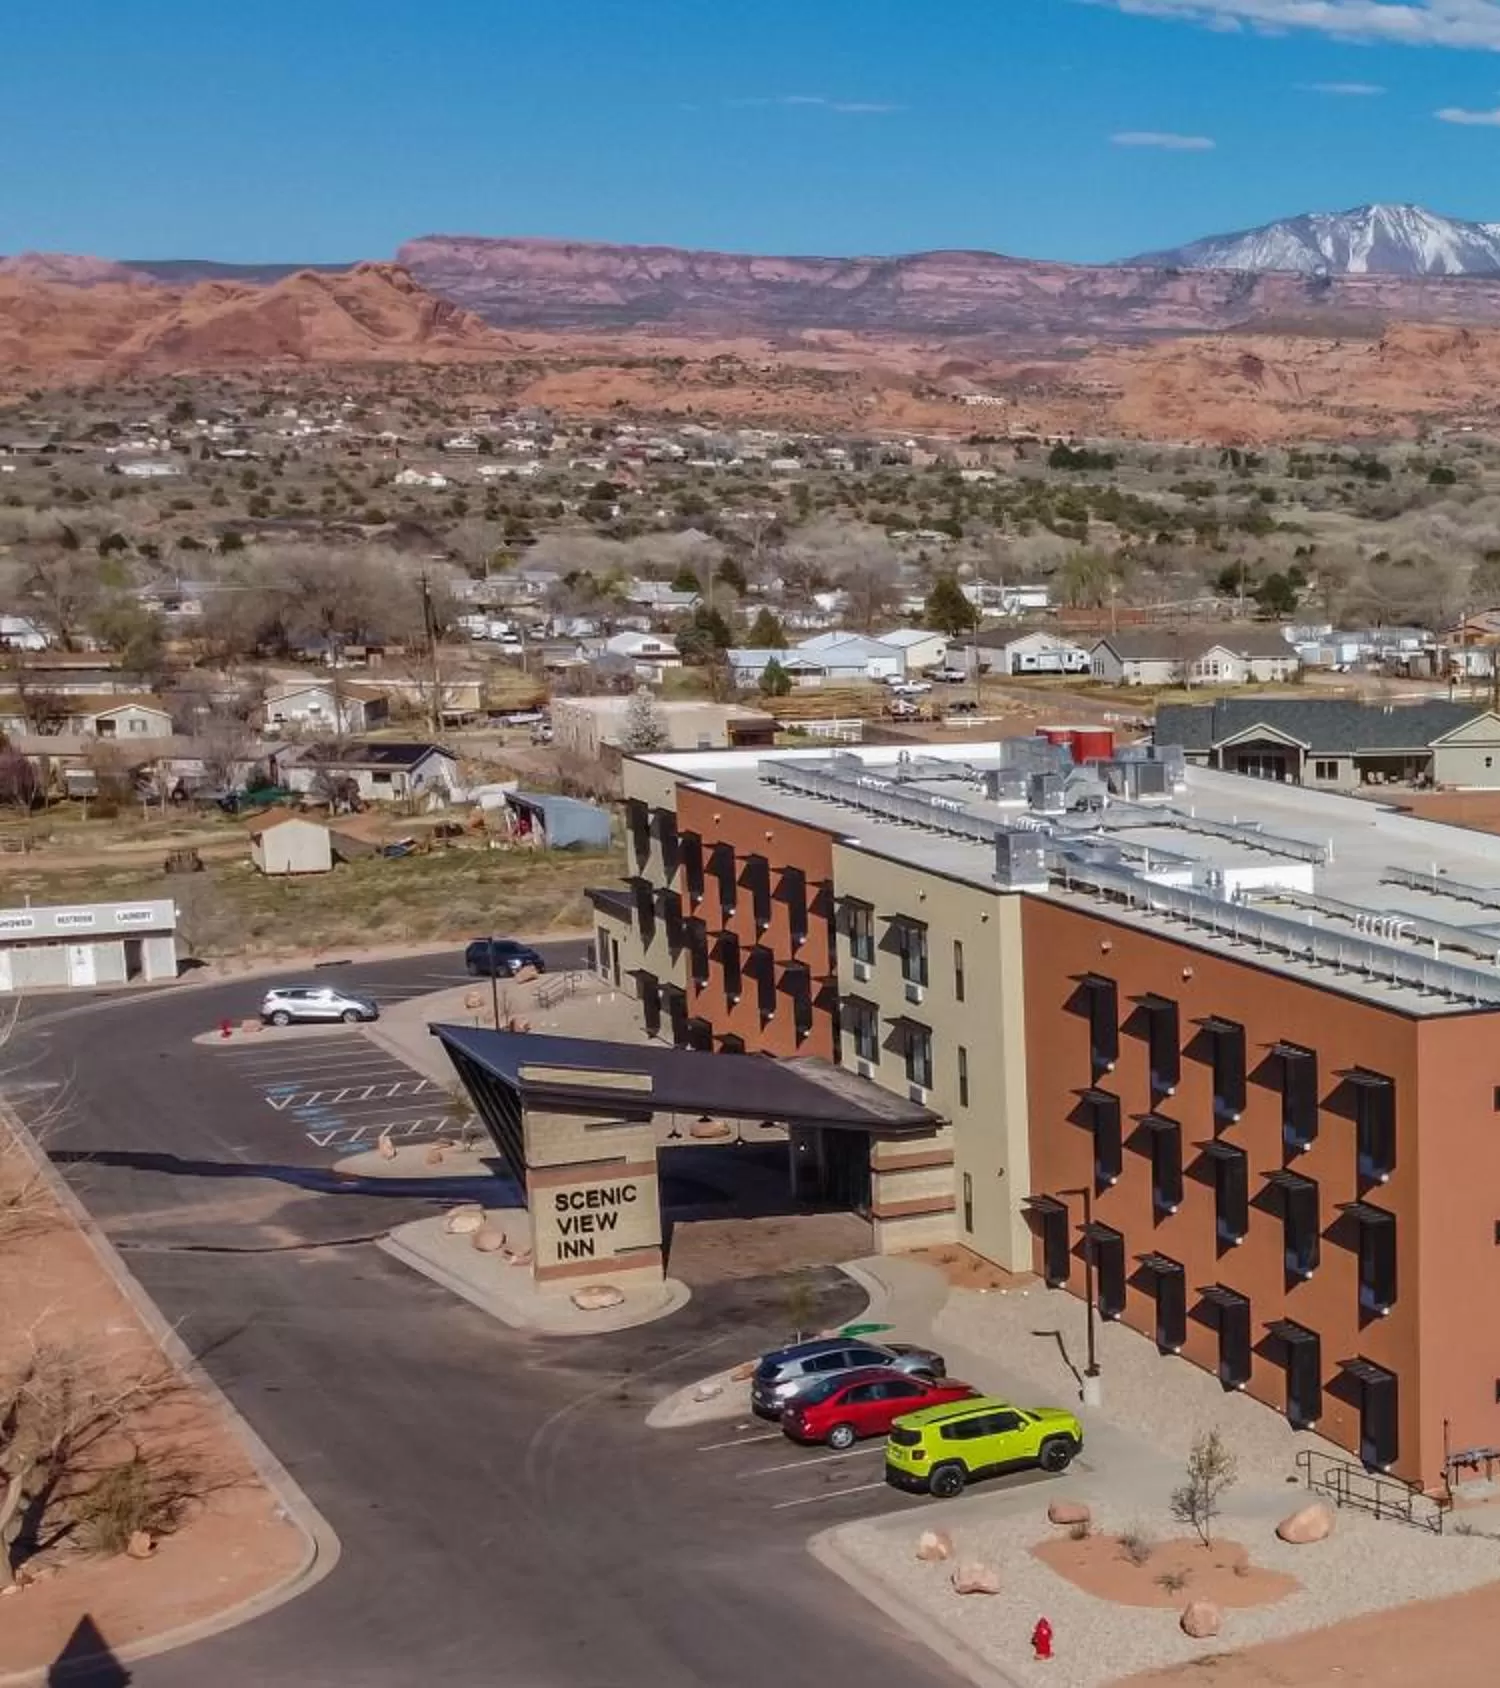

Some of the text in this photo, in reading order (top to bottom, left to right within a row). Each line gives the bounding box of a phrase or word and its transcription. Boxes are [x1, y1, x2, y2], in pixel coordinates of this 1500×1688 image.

[555, 1184, 637, 1211] SCENIC
[556, 1211, 618, 1236] VIEW
[557, 1238, 594, 1260] INN
